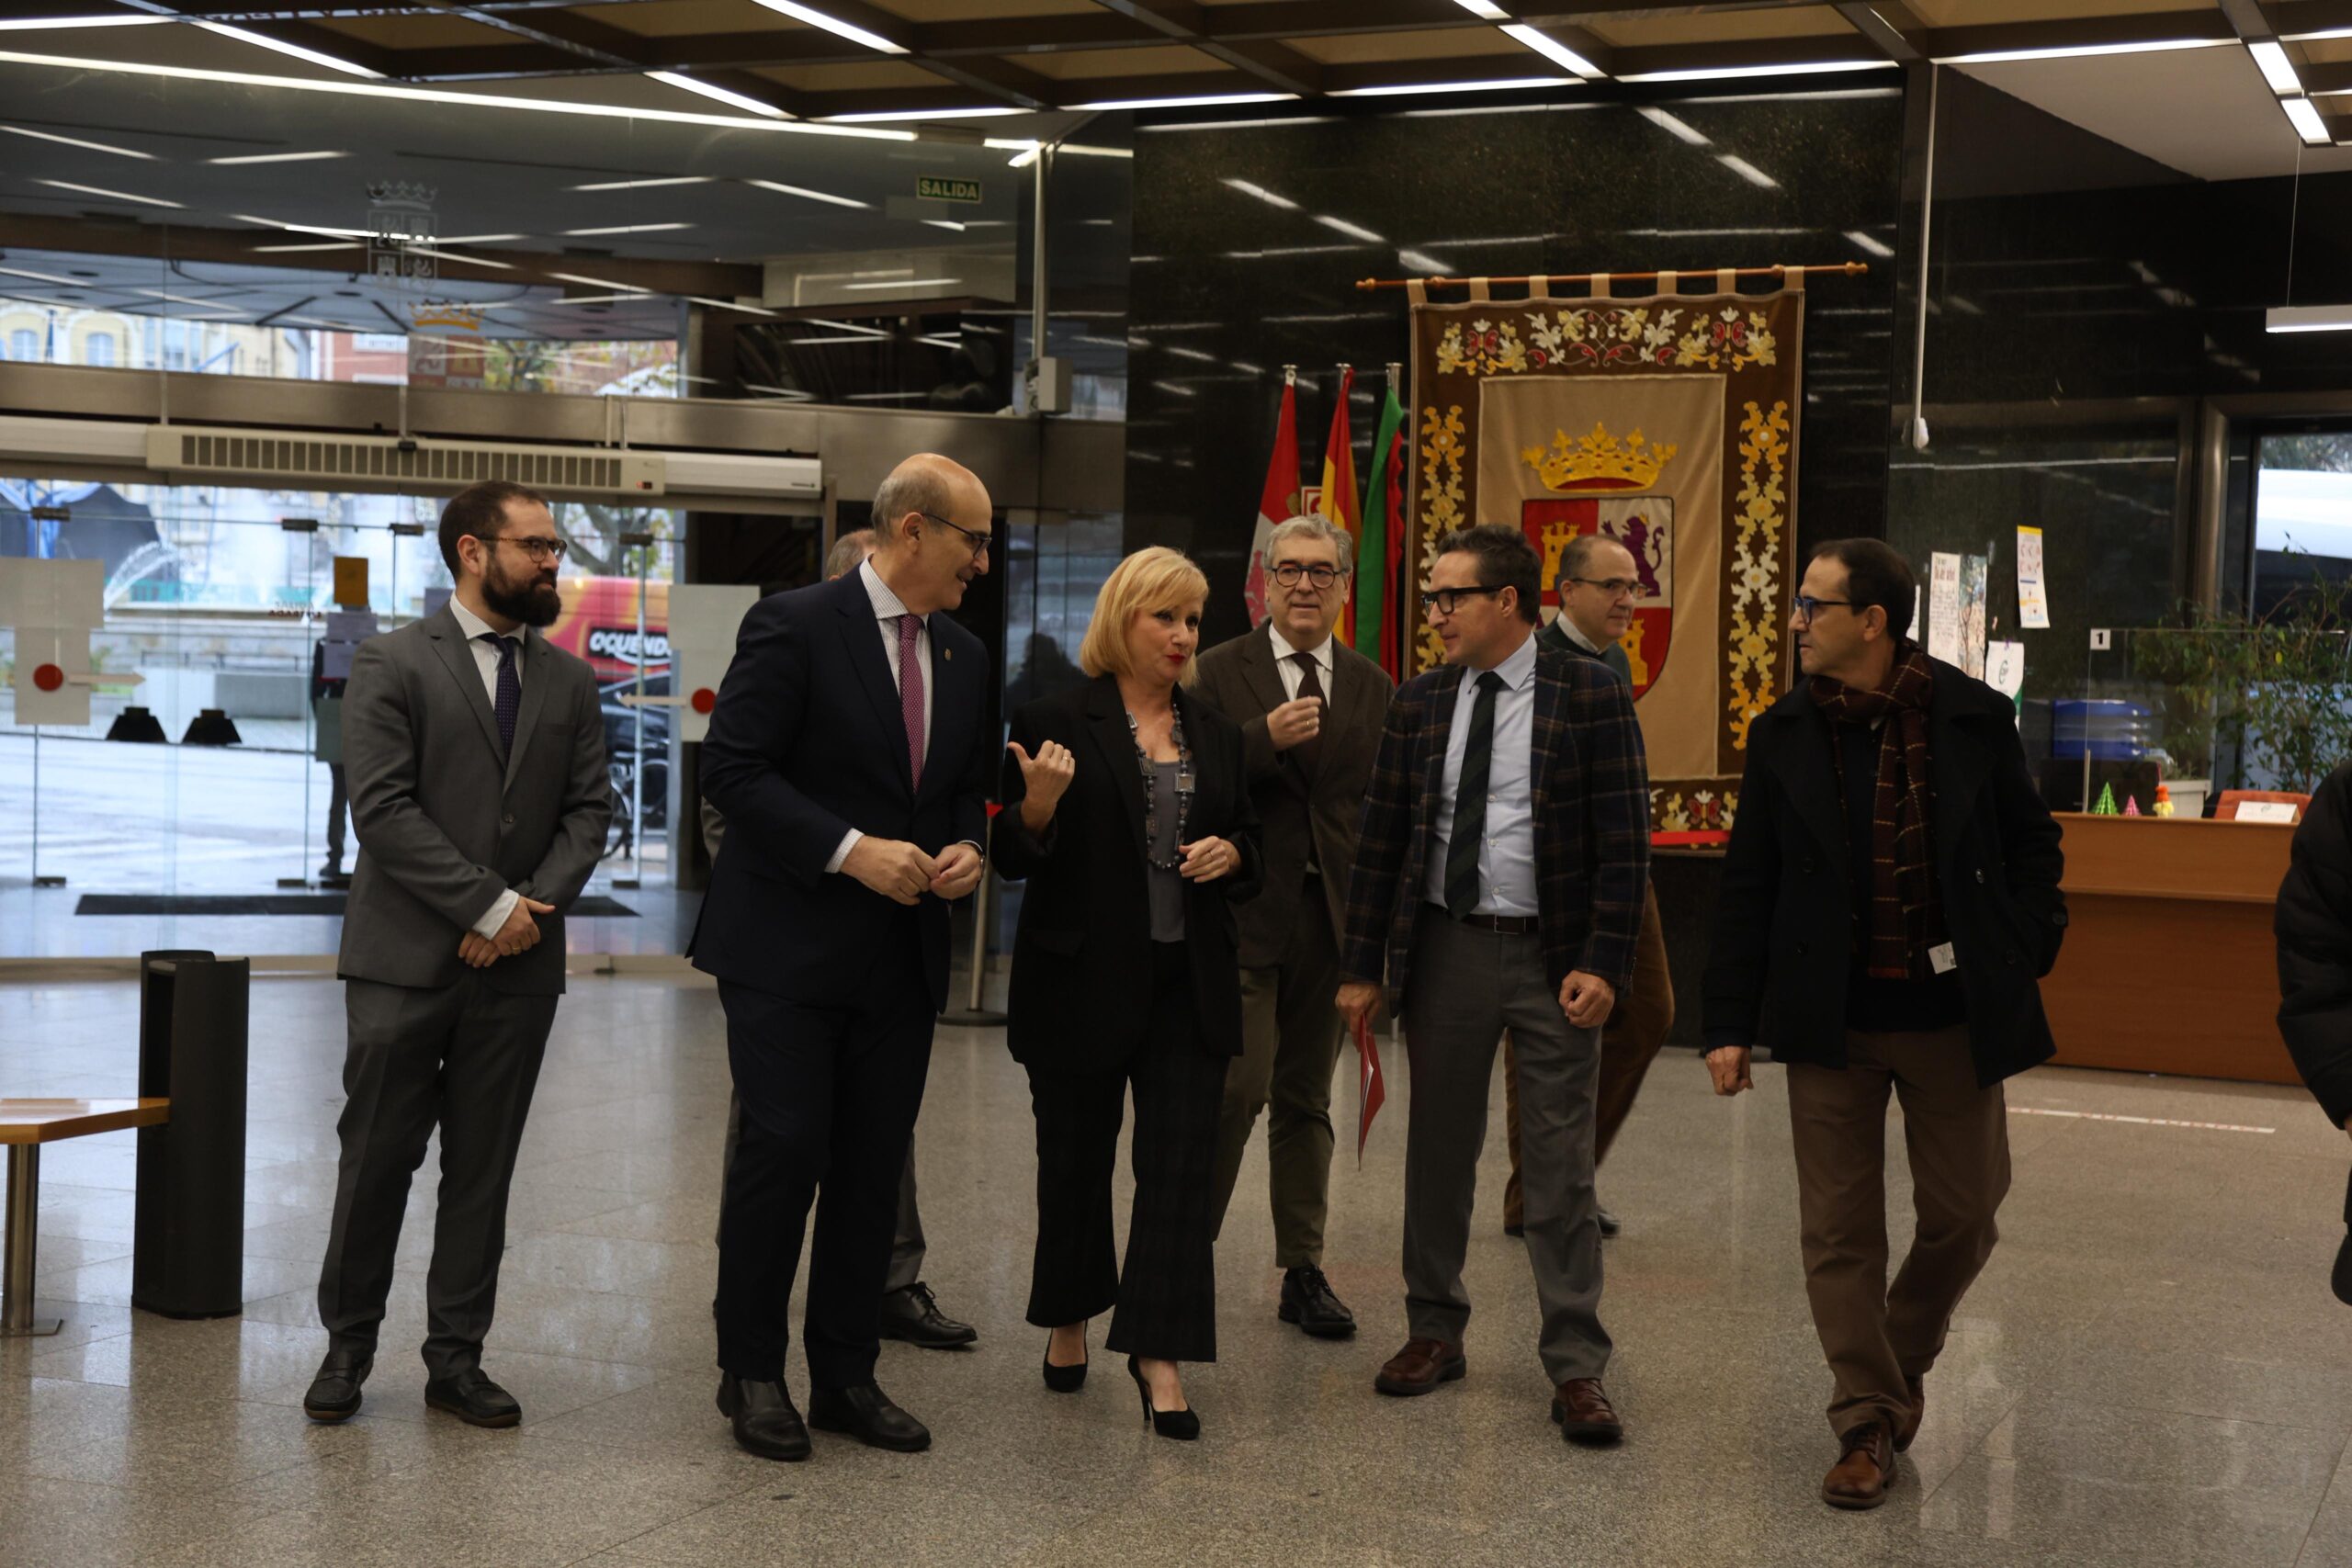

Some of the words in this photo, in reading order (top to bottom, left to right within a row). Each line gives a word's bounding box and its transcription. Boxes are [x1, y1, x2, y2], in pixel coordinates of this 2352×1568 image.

[921, 180, 978, 198] SALIDA
[589, 632, 672, 656] OQUEND
[2096, 631, 2104, 646] 1
